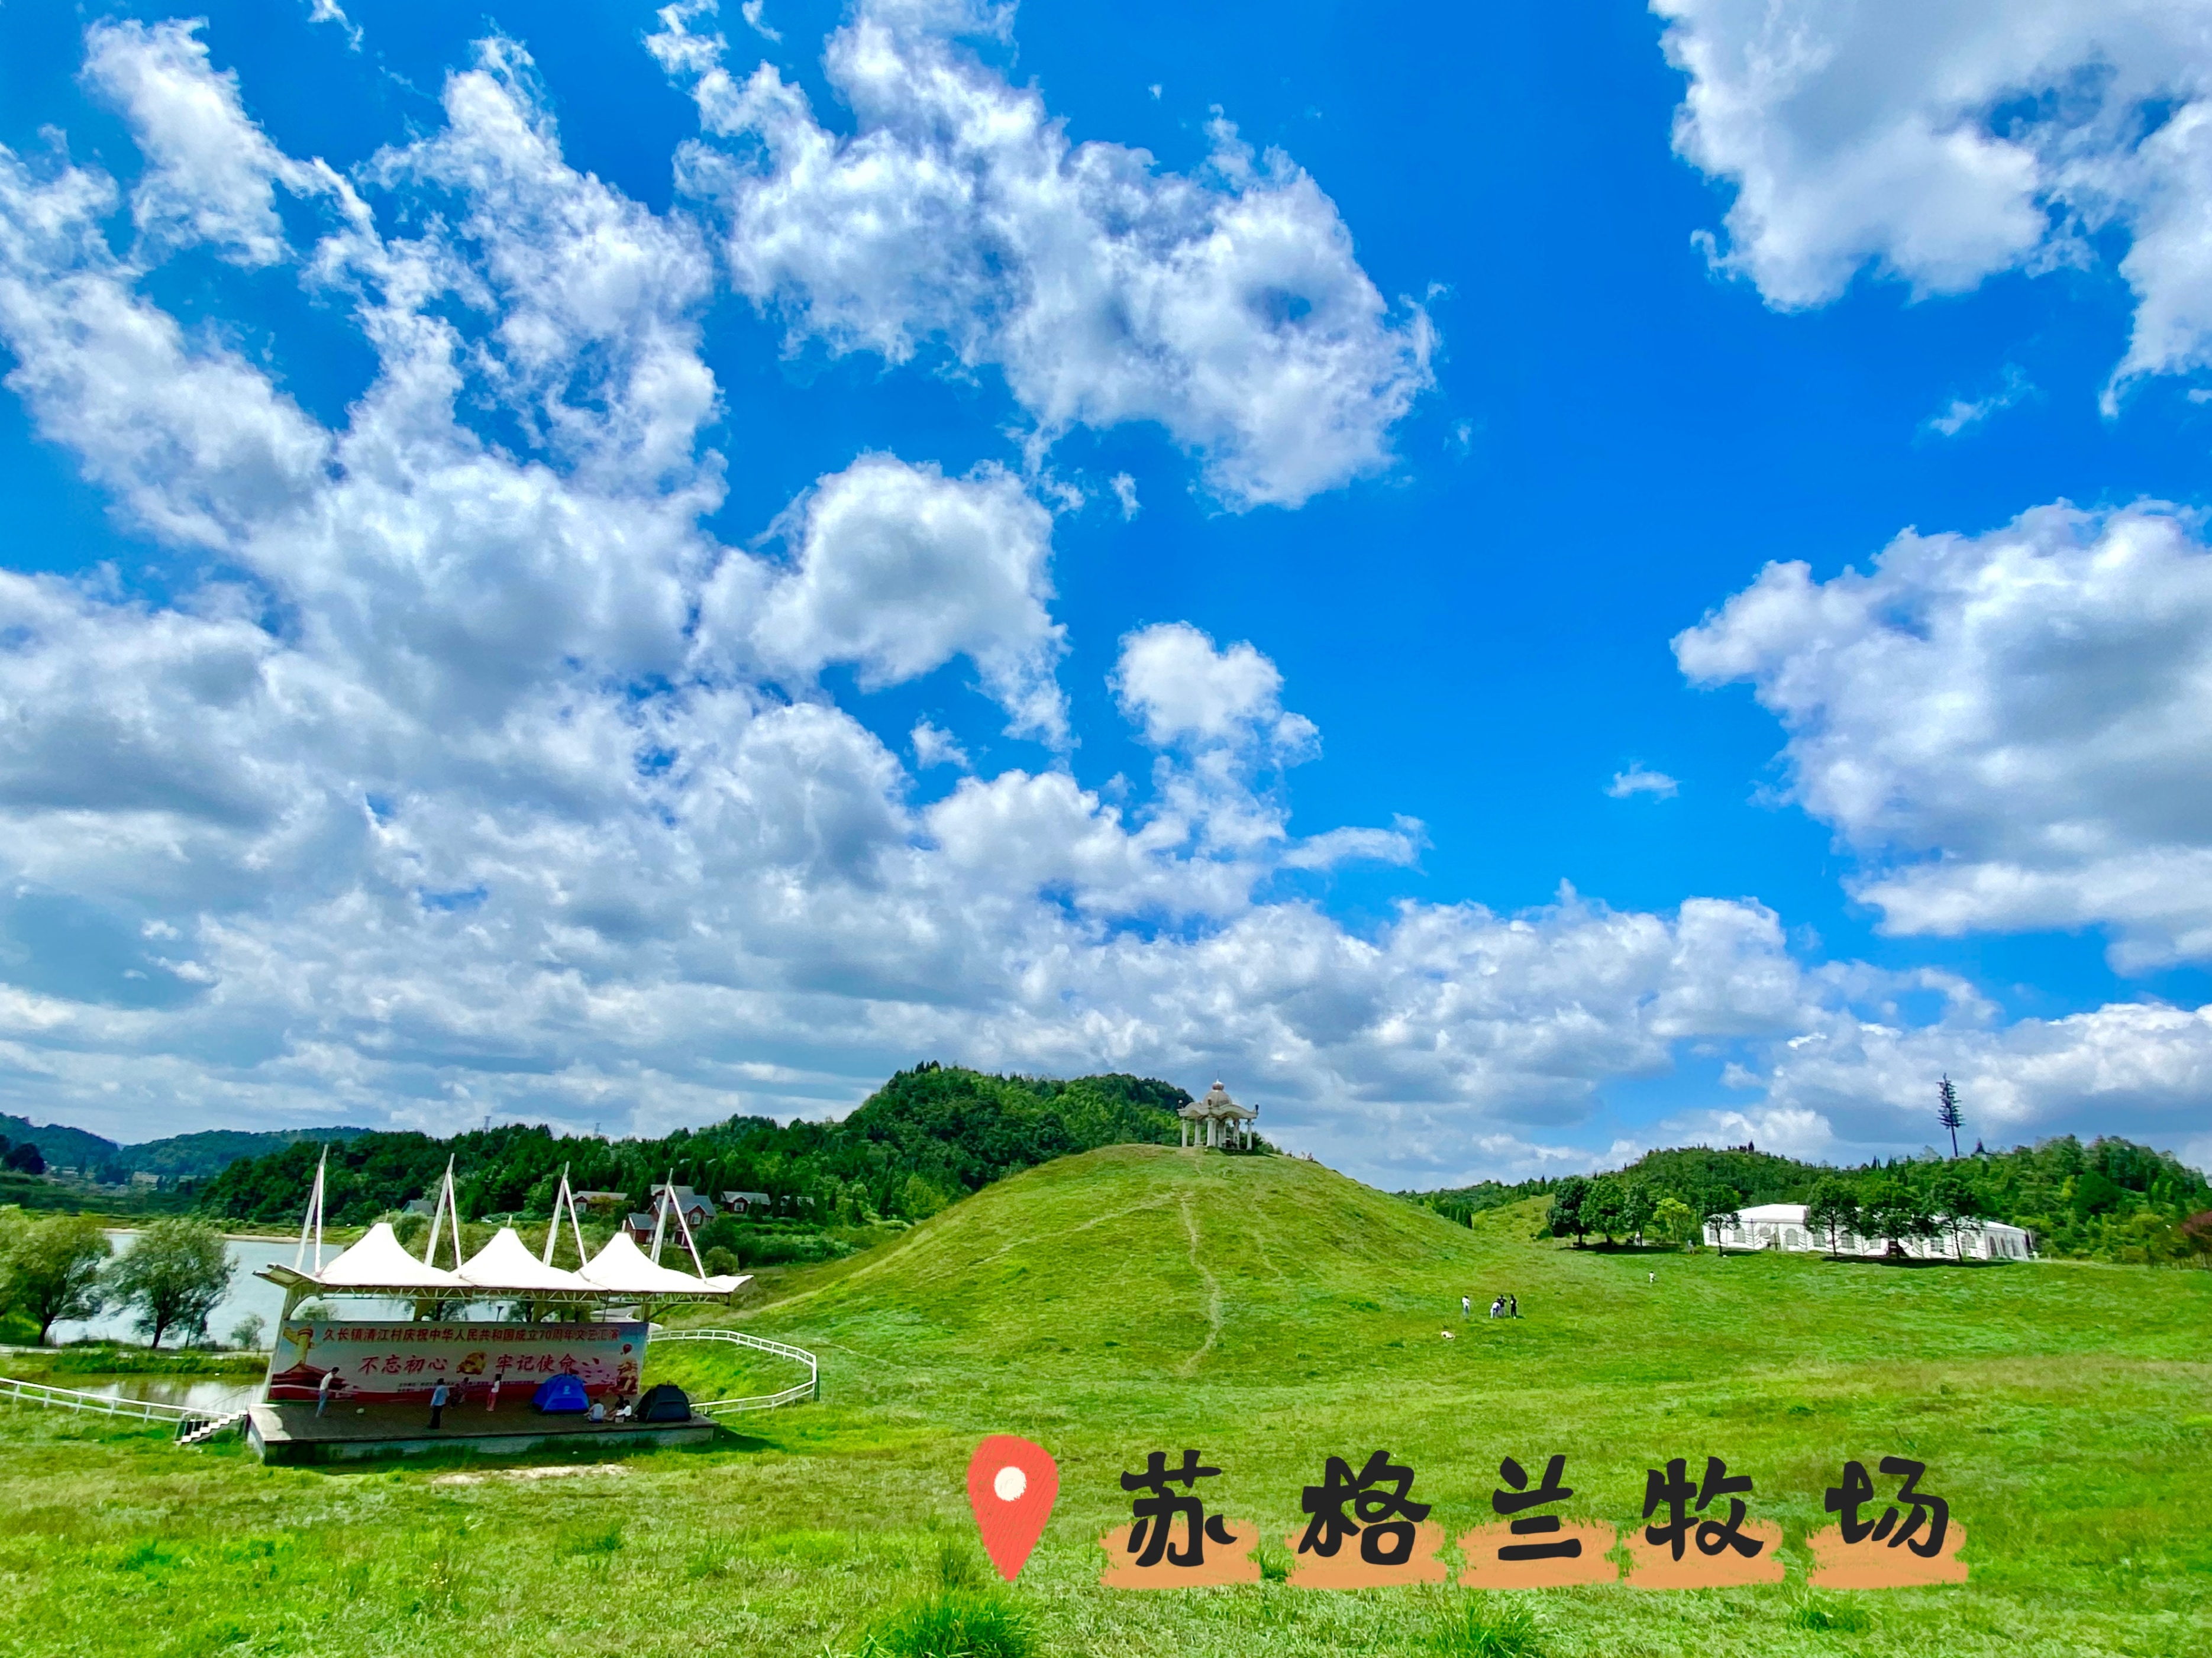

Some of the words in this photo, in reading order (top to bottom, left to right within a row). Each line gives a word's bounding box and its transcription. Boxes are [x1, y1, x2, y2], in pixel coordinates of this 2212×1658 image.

[323, 1327, 619, 1342] 久长镇清江村庆祝中华人民共和国成立70周年文艺汇演
[359, 1355, 447, 1375] 不忘初心
[495, 1353, 578, 1375] 牢记使命
